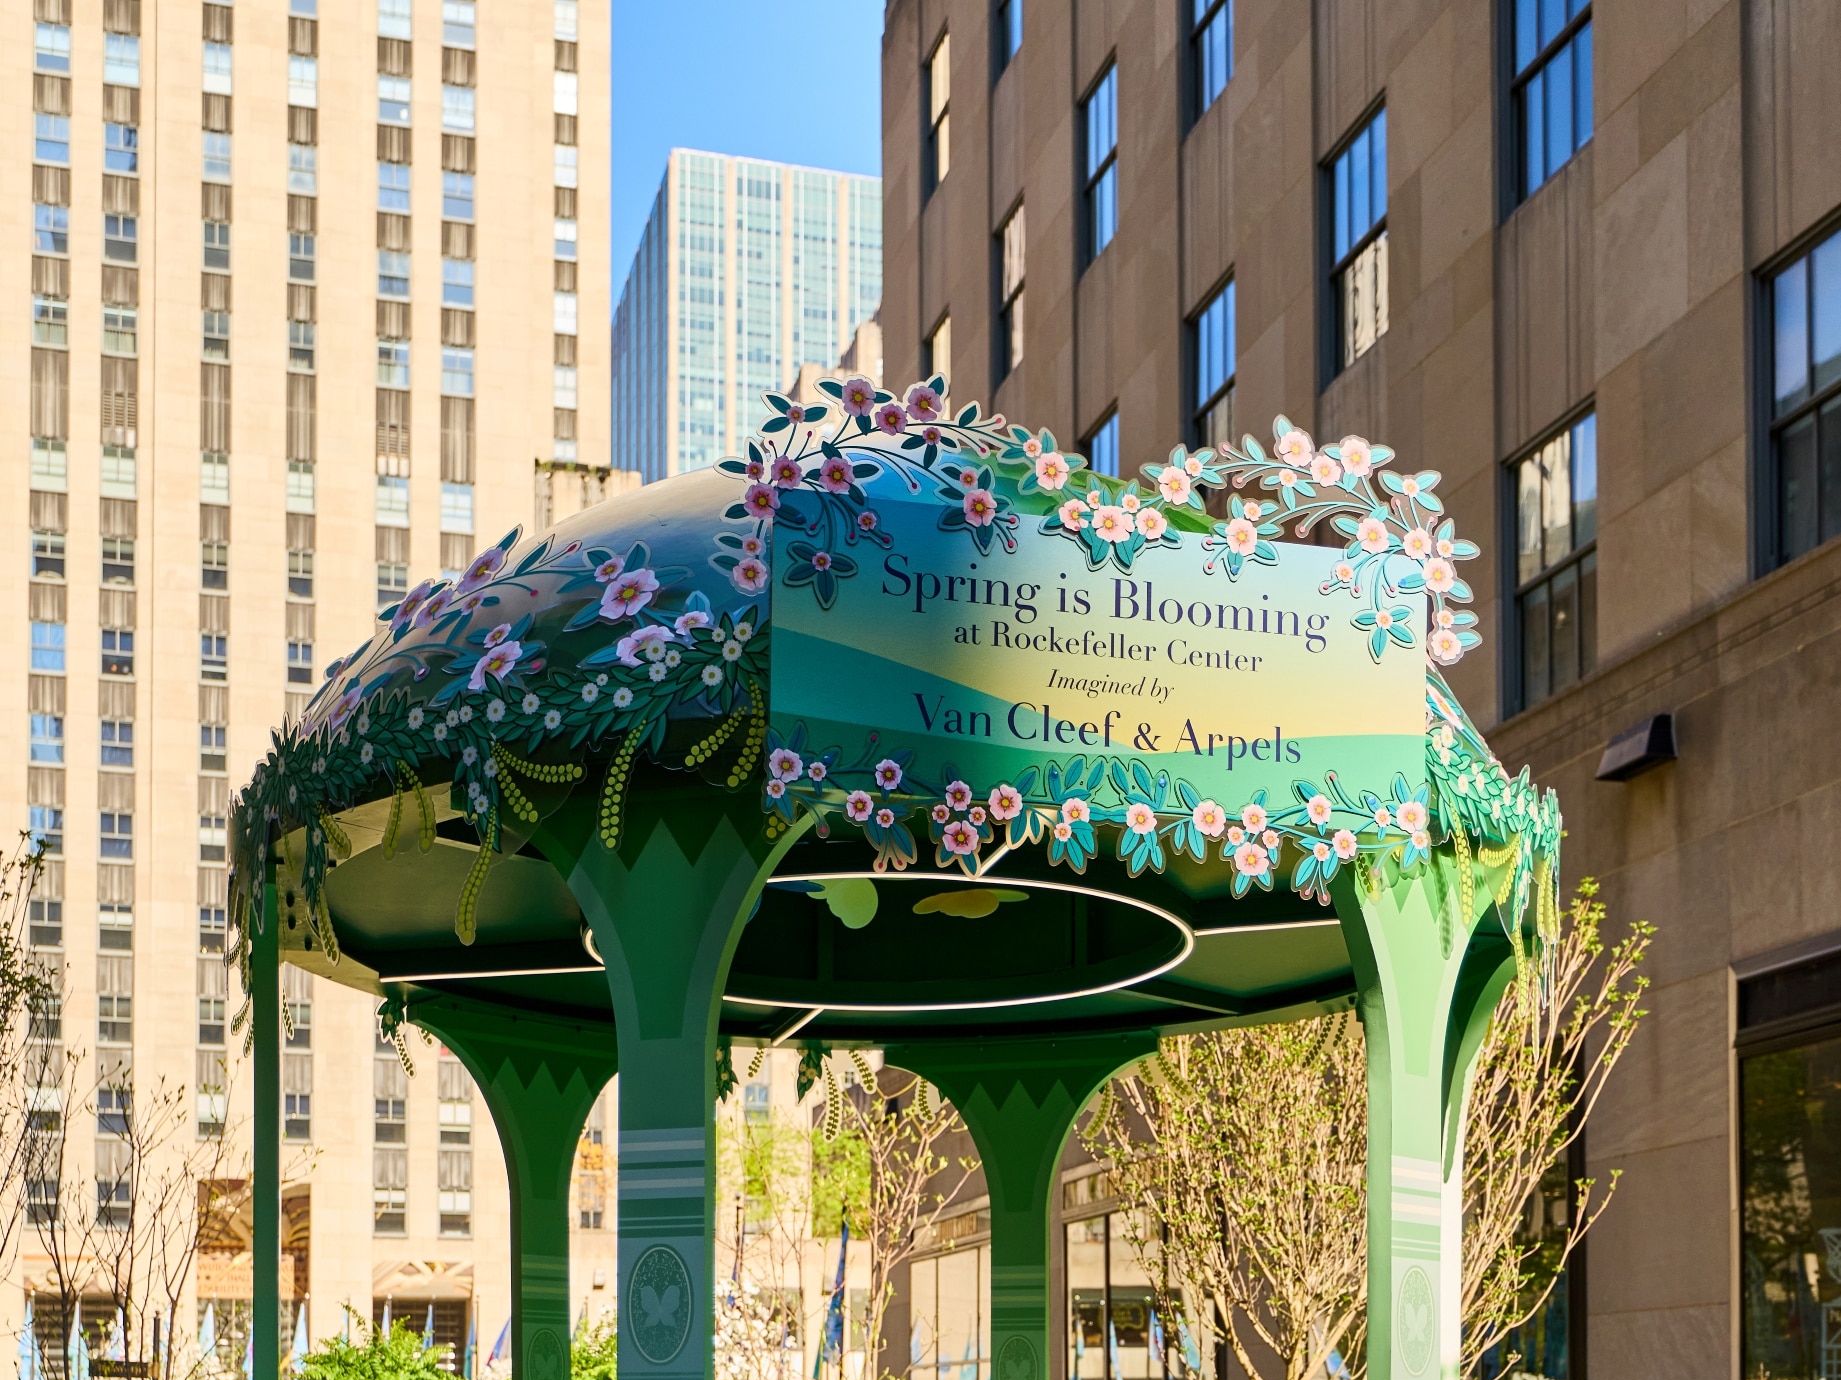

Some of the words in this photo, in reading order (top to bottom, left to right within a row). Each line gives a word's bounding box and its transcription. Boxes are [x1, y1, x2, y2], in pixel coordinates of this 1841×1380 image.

[882, 553, 1041, 624] Spring
[1056, 572, 1091, 615] is
[1109, 577, 1330, 653] Blooming
[954, 623, 982, 646] at
[990, 620, 1157, 662] Rockefeller
[1167, 638, 1263, 673] Center
[1046, 668, 1147, 699] Imagined
[1150, 677, 1175, 704] by
[912, 692, 991, 737] Van
[1007, 701, 1121, 748] Cleef
[1133, 721, 1161, 752] &
[1174, 717, 1302, 771] Arpels
